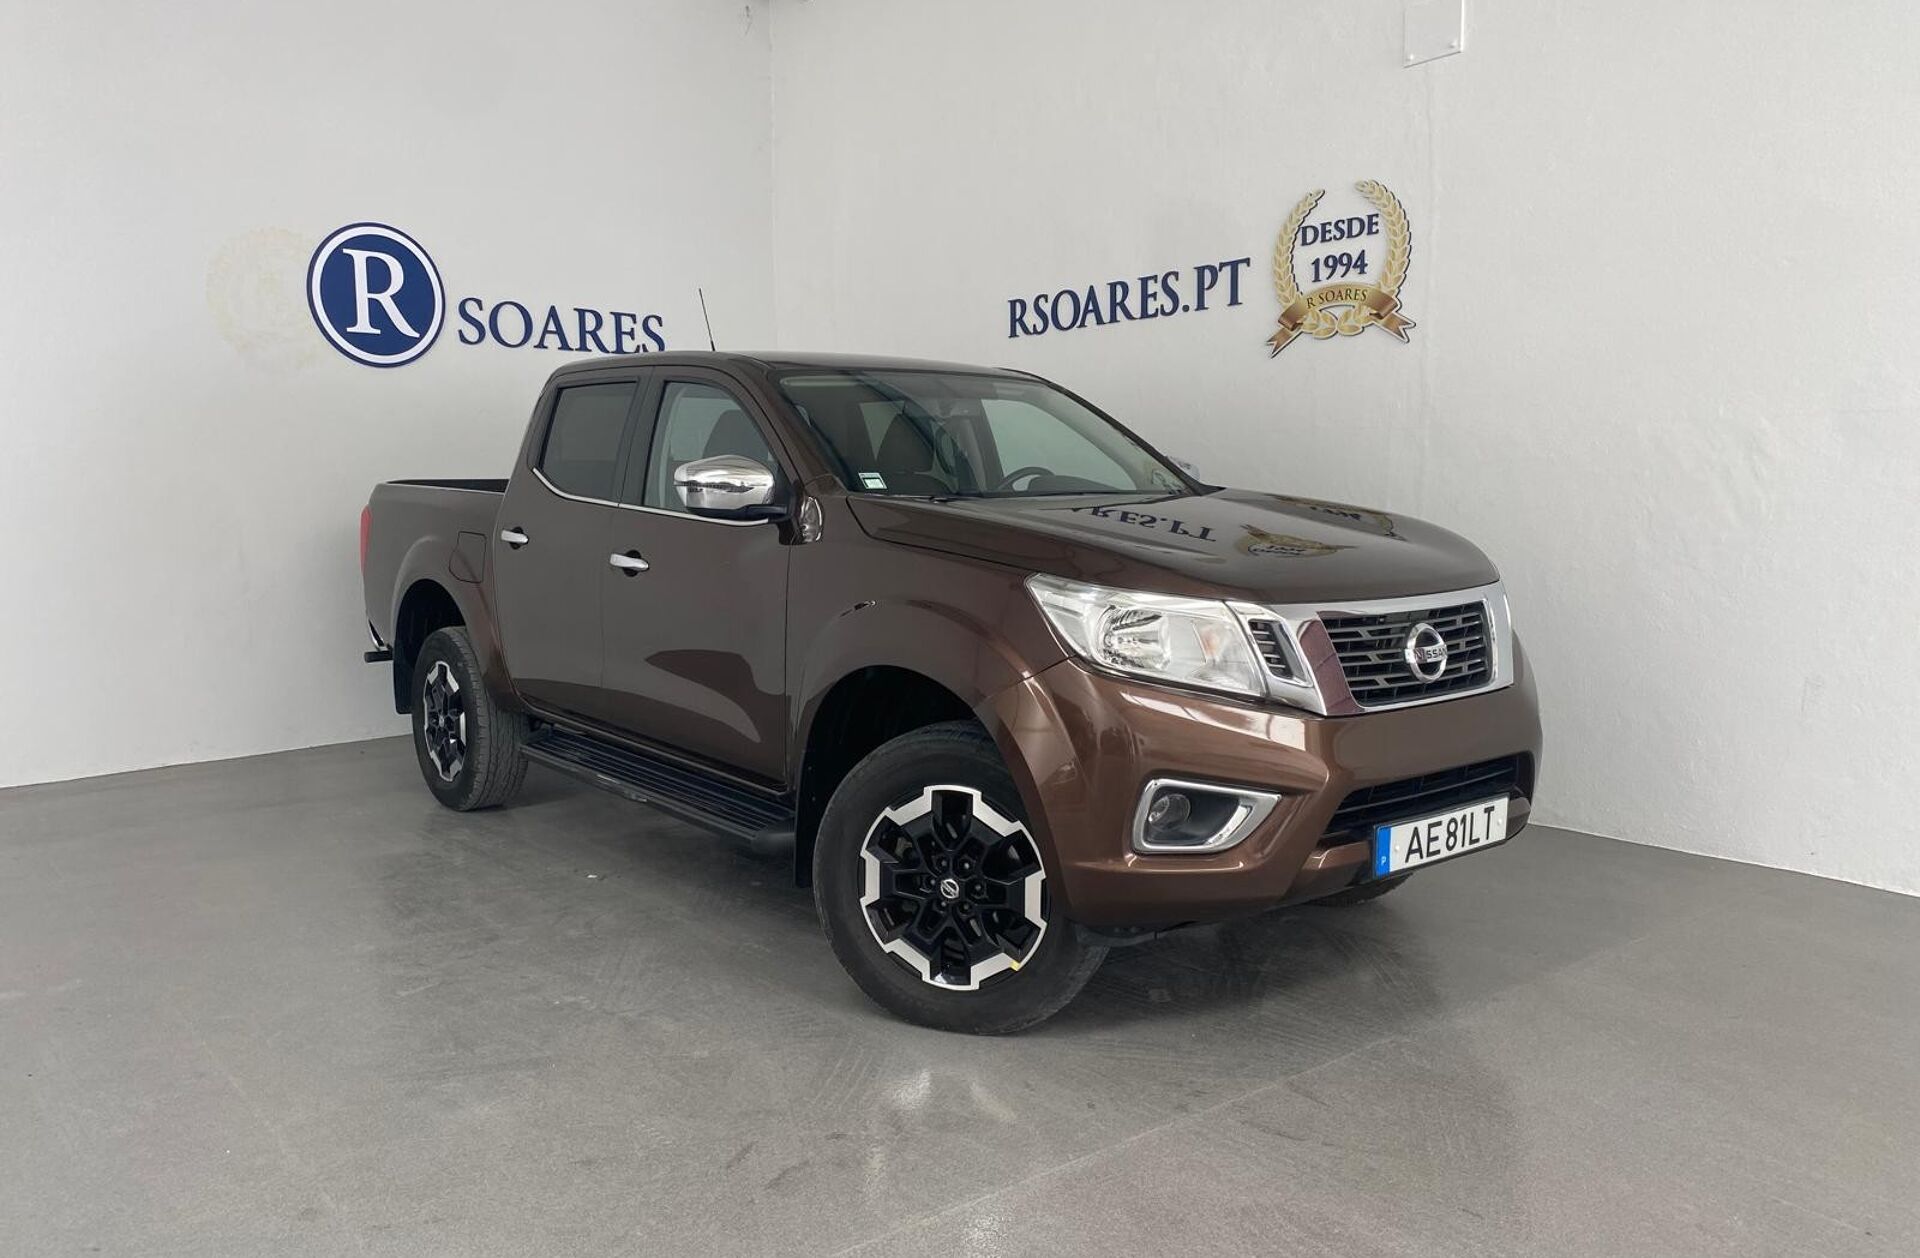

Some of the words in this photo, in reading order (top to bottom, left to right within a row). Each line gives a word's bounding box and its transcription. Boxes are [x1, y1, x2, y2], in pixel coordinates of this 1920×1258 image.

[1301, 213, 1379, 246] DESDE
[1311, 249, 1368, 282] 1994
[342, 248, 420, 338] R
[457, 297, 665, 354] SOARES
[1008, 257, 1250, 338] RSOARES.PT
[1306, 297, 1316, 309] R
[1318, 288, 1368, 304] SOARES
[1405, 806, 1495, 863] AE81LT
